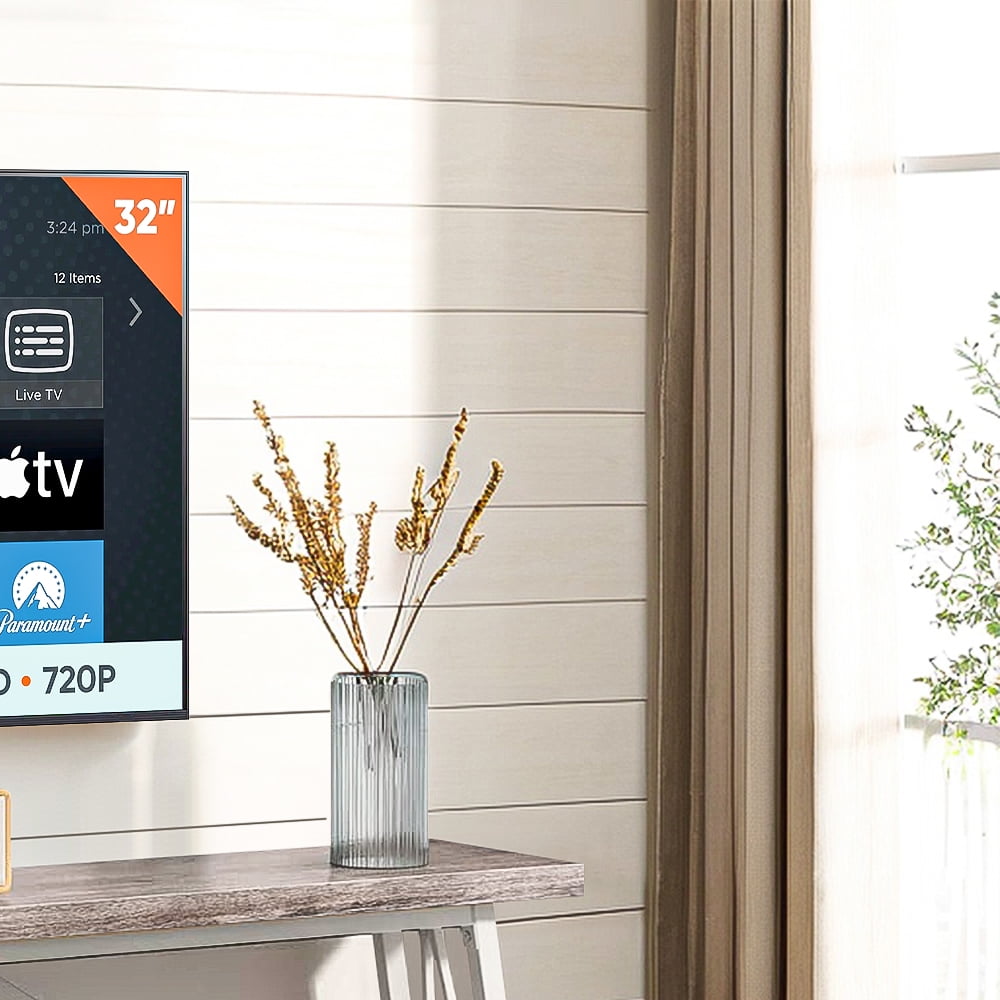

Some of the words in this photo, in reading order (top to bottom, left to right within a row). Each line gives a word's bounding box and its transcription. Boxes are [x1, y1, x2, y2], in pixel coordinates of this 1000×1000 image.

[47, 221, 76, 233] 3:24
[53, 272, 66, 284] 12
[69, 272, 102, 284] Items
[15, 388, 40, 401] Live
[45, 389, 62, 400] TV
[34, 452, 83, 497] tv
[43, 665, 115, 694] 720P
